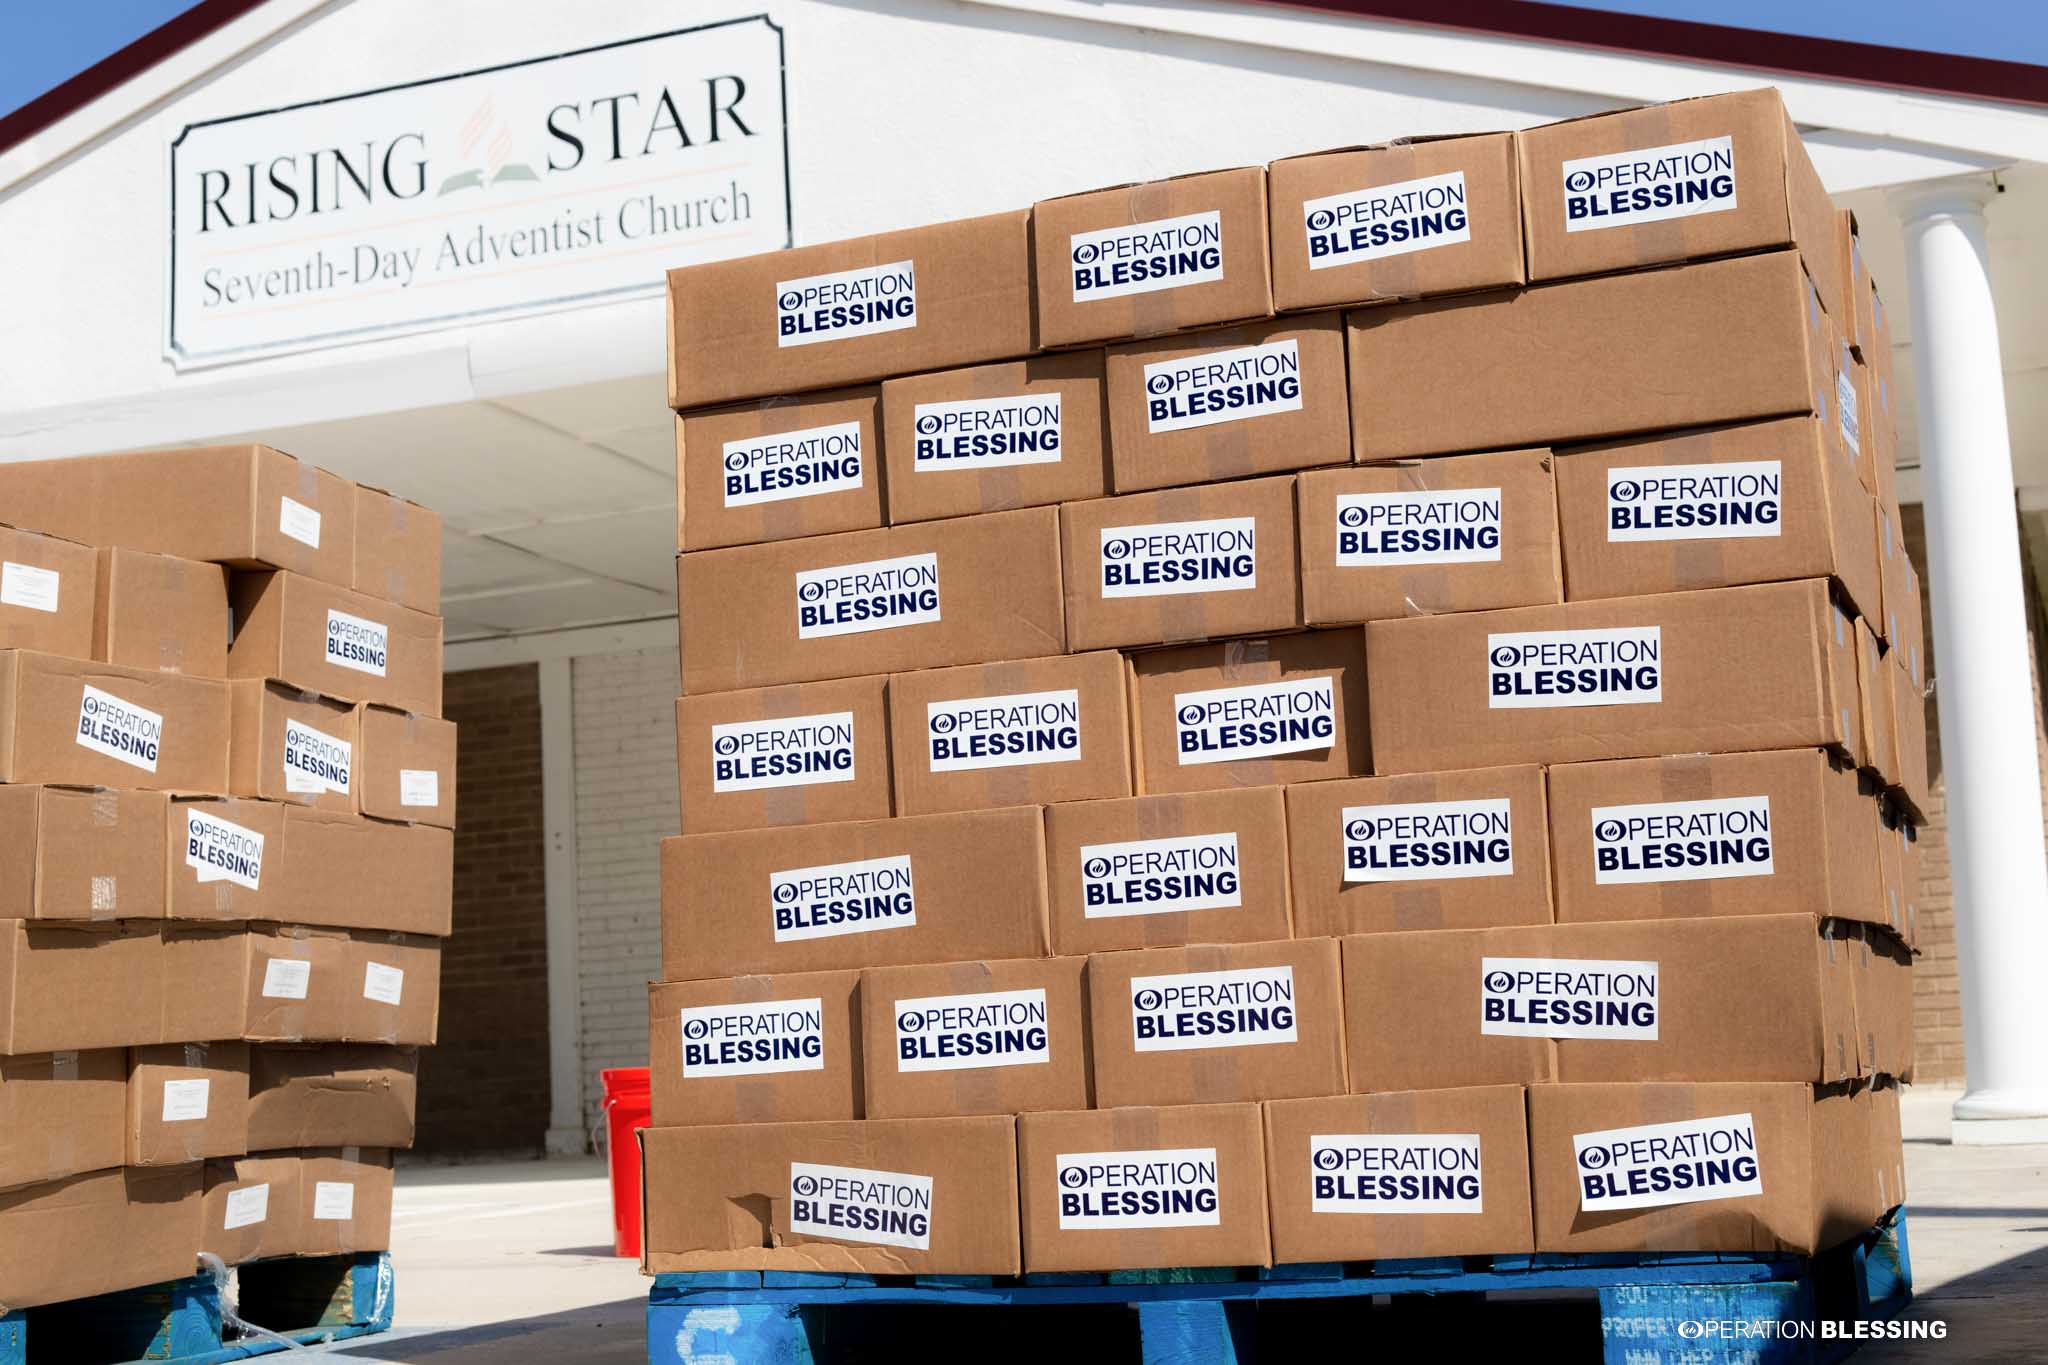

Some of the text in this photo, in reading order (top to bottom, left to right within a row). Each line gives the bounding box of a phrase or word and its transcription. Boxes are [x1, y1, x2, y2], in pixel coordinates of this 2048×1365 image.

[196, 75, 758, 233] RISING STAR
[1565, 148, 1732, 193] OPERATION
[1306, 183, 1464, 231] OPERATION
[1567, 174, 1733, 220] BLESSING
[203, 181, 751, 307] Seventh-Day Adventist Church
[1073, 221, 1219, 265] OPERATION
[1309, 208, 1467, 258] BLESSING
[1074, 247, 1220, 291] BLESSING
[778, 271, 913, 311] OPERATION
[780, 295, 914, 337] BLESSING
[1147, 351, 1297, 395] OPERATION
[1149, 376, 1299, 422] BLESSING
[916, 404, 1059, 435] OPERATION
[725, 432, 859, 472] OPERATION
[917, 429, 1059, 461] BLESSING
[726, 456, 860, 496] BLESSING
[1610, 473, 1778, 503] OPERATION
[1338, 500, 1499, 528] OPERATION
[1611, 500, 1778, 530] BLESSING
[1103, 529, 1253, 560] OPERATION
[1339, 526, 1499, 554] BLESSING
[799, 564, 936, 602] OPERATION
[1104, 554, 1253, 586] BLESSING
[800, 589, 938, 628] BLESSING
[328, 637, 385, 668] BLESSING
[1490, 639, 1658, 668] OPERATION
[1492, 666, 1658, 696] BLESSING
[930, 701, 1077, 734] OPERATION
[1178, 689, 1331, 726] OPERATION
[80, 715, 157, 761] BLESSING
[714, 723, 851, 756] OPERATION
[932, 726, 1078, 760] BLESSING
[1180, 715, 1333, 753] BLESSING
[286, 747, 348, 785] BLESSING
[716, 748, 852, 781] BLESSING
[1345, 811, 1509, 842] OPERATION
[1594, 809, 1768, 843] OPERATION
[189, 837, 258, 879] BLESSING
[1083, 845, 1236, 879] OPERATION
[1347, 838, 1510, 869] BLESSING
[1597, 837, 1770, 872] BLESSING
[773, 866, 911, 904] OPERATION
[1086, 871, 1237, 906] BLESSING
[775, 892, 913, 931] BLESSING
[1133, 978, 1291, 1011] OPERATION
[1484, 971, 1655, 998] OPERATION
[683, 1009, 820, 1040] OPERATION
[897, 1001, 1045, 1033] OPERATION
[1136, 1006, 1293, 1039] BLESSING
[1485, 997, 1655, 1027] BLESSING
[685, 1035, 821, 1066] BLESSING
[900, 1027, 1046, 1060] BLESSING
[1313, 1147, 1479, 1171] OPERATION
[1578, 1127, 1754, 1170] OPERATION
[1059, 1161, 1215, 1189] OPERATION
[1315, 1175, 1479, 1200] BLESSING
[1583, 1156, 1758, 1200] BLESSING
[793, 1175, 930, 1211] OPERATION
[1061, 1188, 1217, 1217] BLESSING
[793, 1199, 927, 1237] BLESSING
